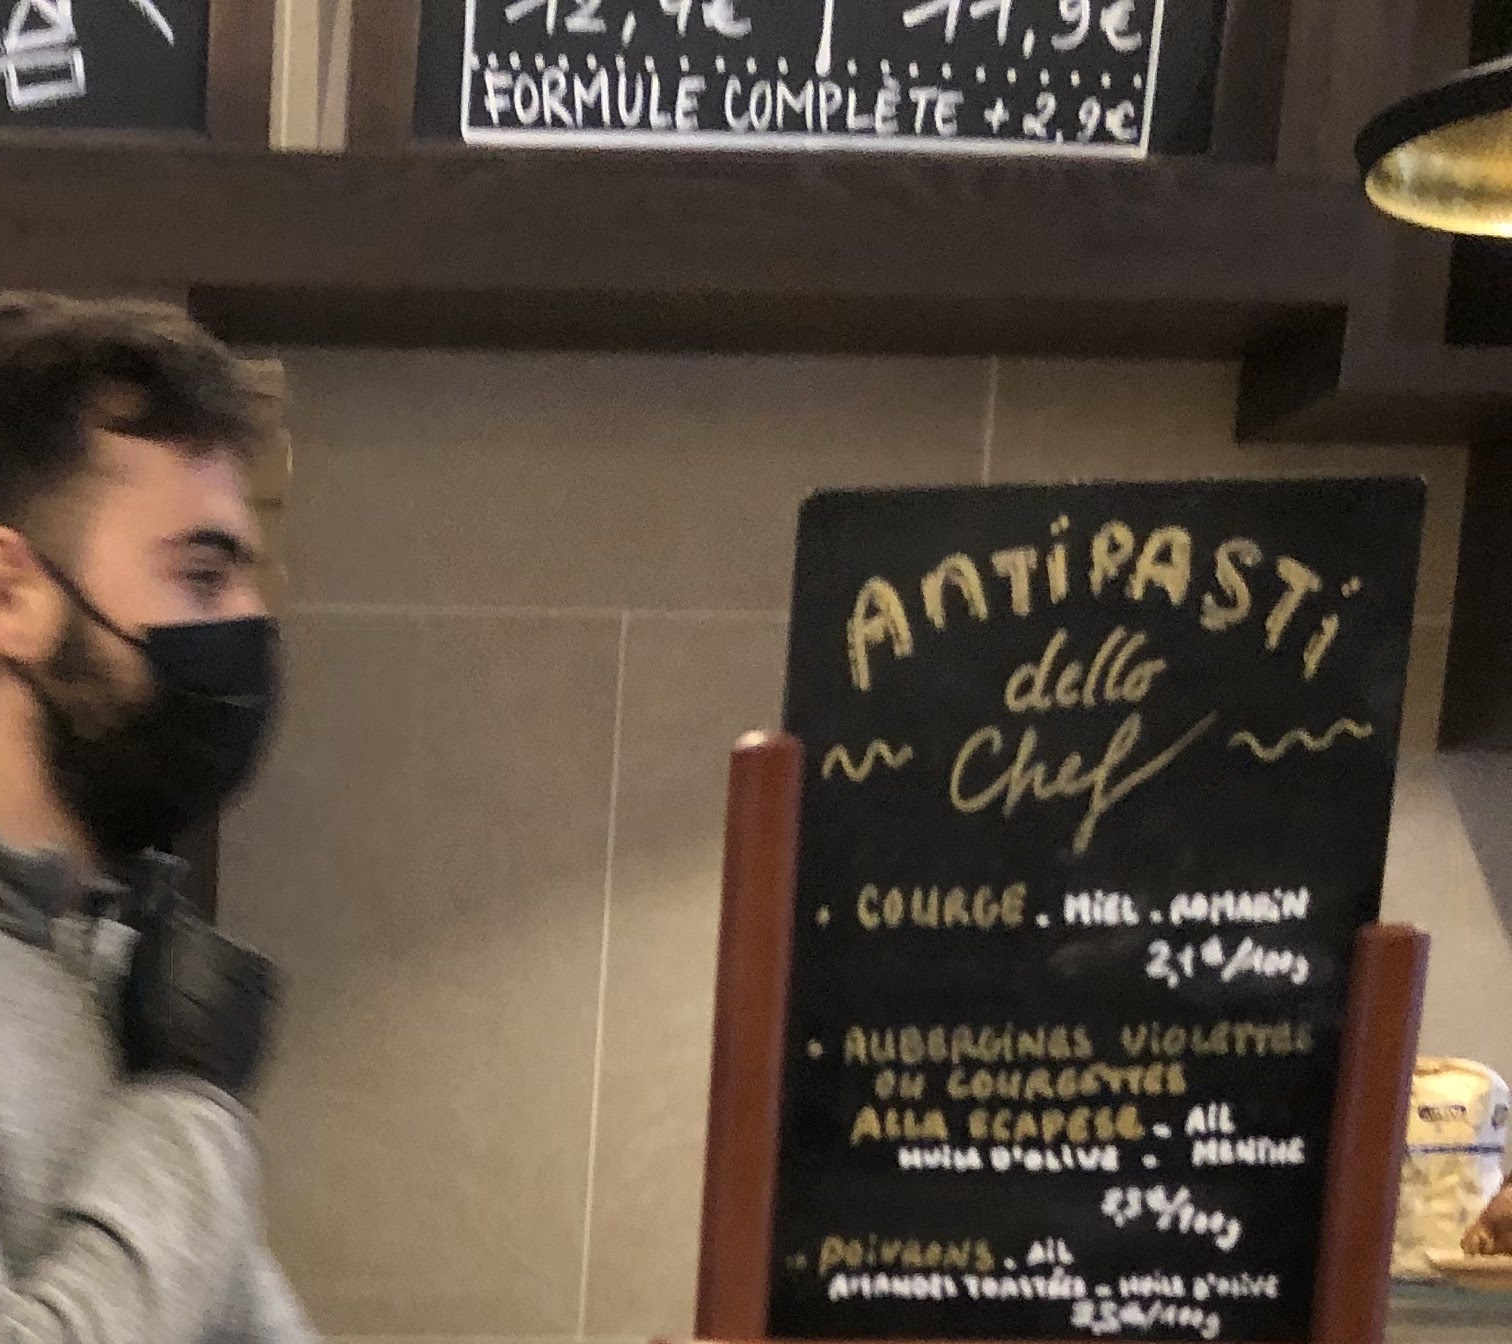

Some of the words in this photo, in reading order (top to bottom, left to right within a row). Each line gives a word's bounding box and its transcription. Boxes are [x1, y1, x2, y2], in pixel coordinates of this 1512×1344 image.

[484, 65, 706, 130] FORMULE
[724, 72, 964, 137] COMPLÈTE
[950, 710, 1218, 854] Chef
[857, 882, 1027, 930] COURGE
